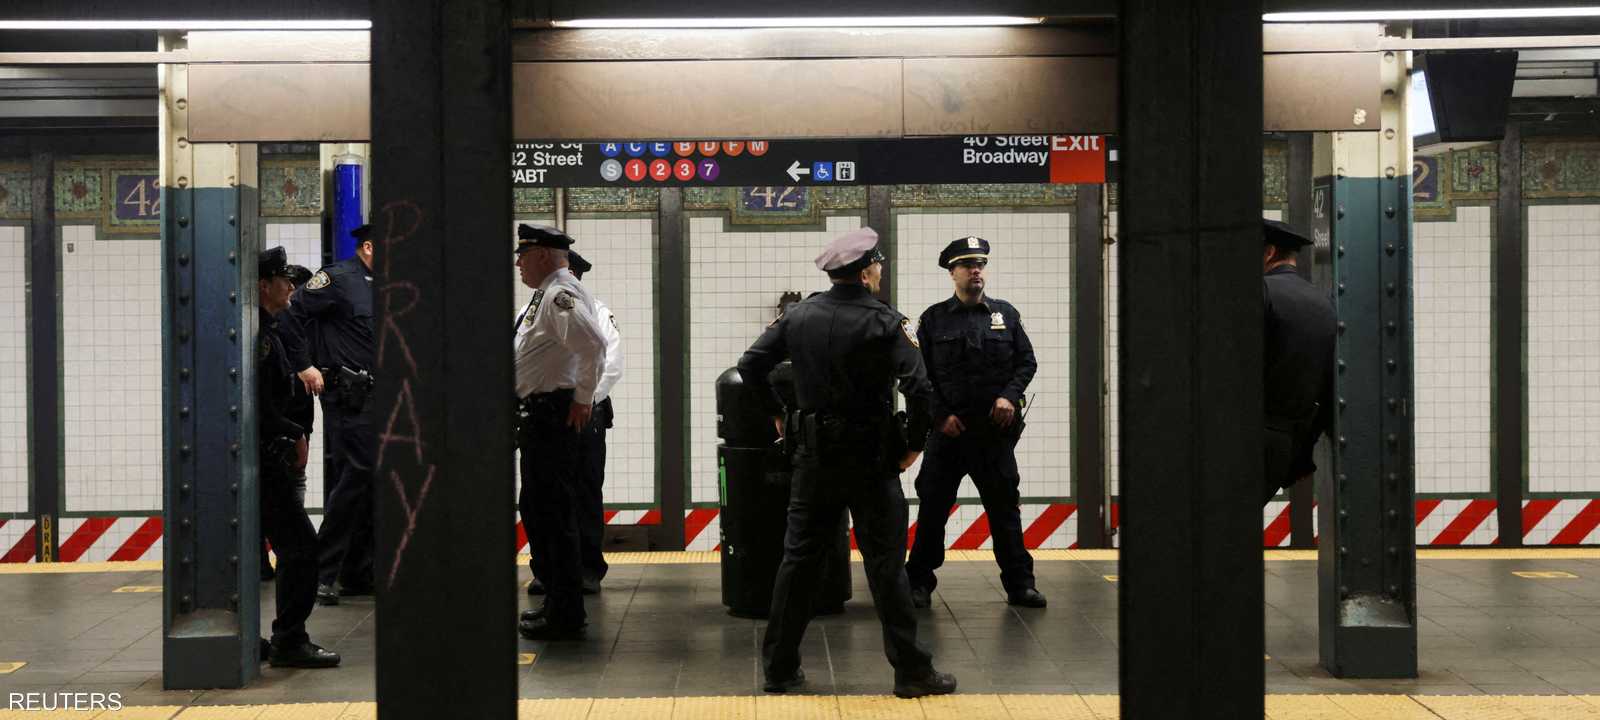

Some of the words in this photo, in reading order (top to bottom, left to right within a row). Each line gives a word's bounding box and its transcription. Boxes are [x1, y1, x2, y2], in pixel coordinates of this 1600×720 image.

[963, 136, 988, 147] 40
[995, 136, 1049, 147] Street
[1051, 136, 1100, 151] Exit
[533, 152, 583, 166] Street
[963, 148, 1049, 166] Broadway
[606, 164, 617, 176] S
[632, 164, 639, 176] 1
[656, 164, 665, 176] 2
[680, 164, 690, 176] 3
[705, 164, 714, 176] 7
[750, 187, 797, 208] 42
[376, 200, 437, 590] PRAY
